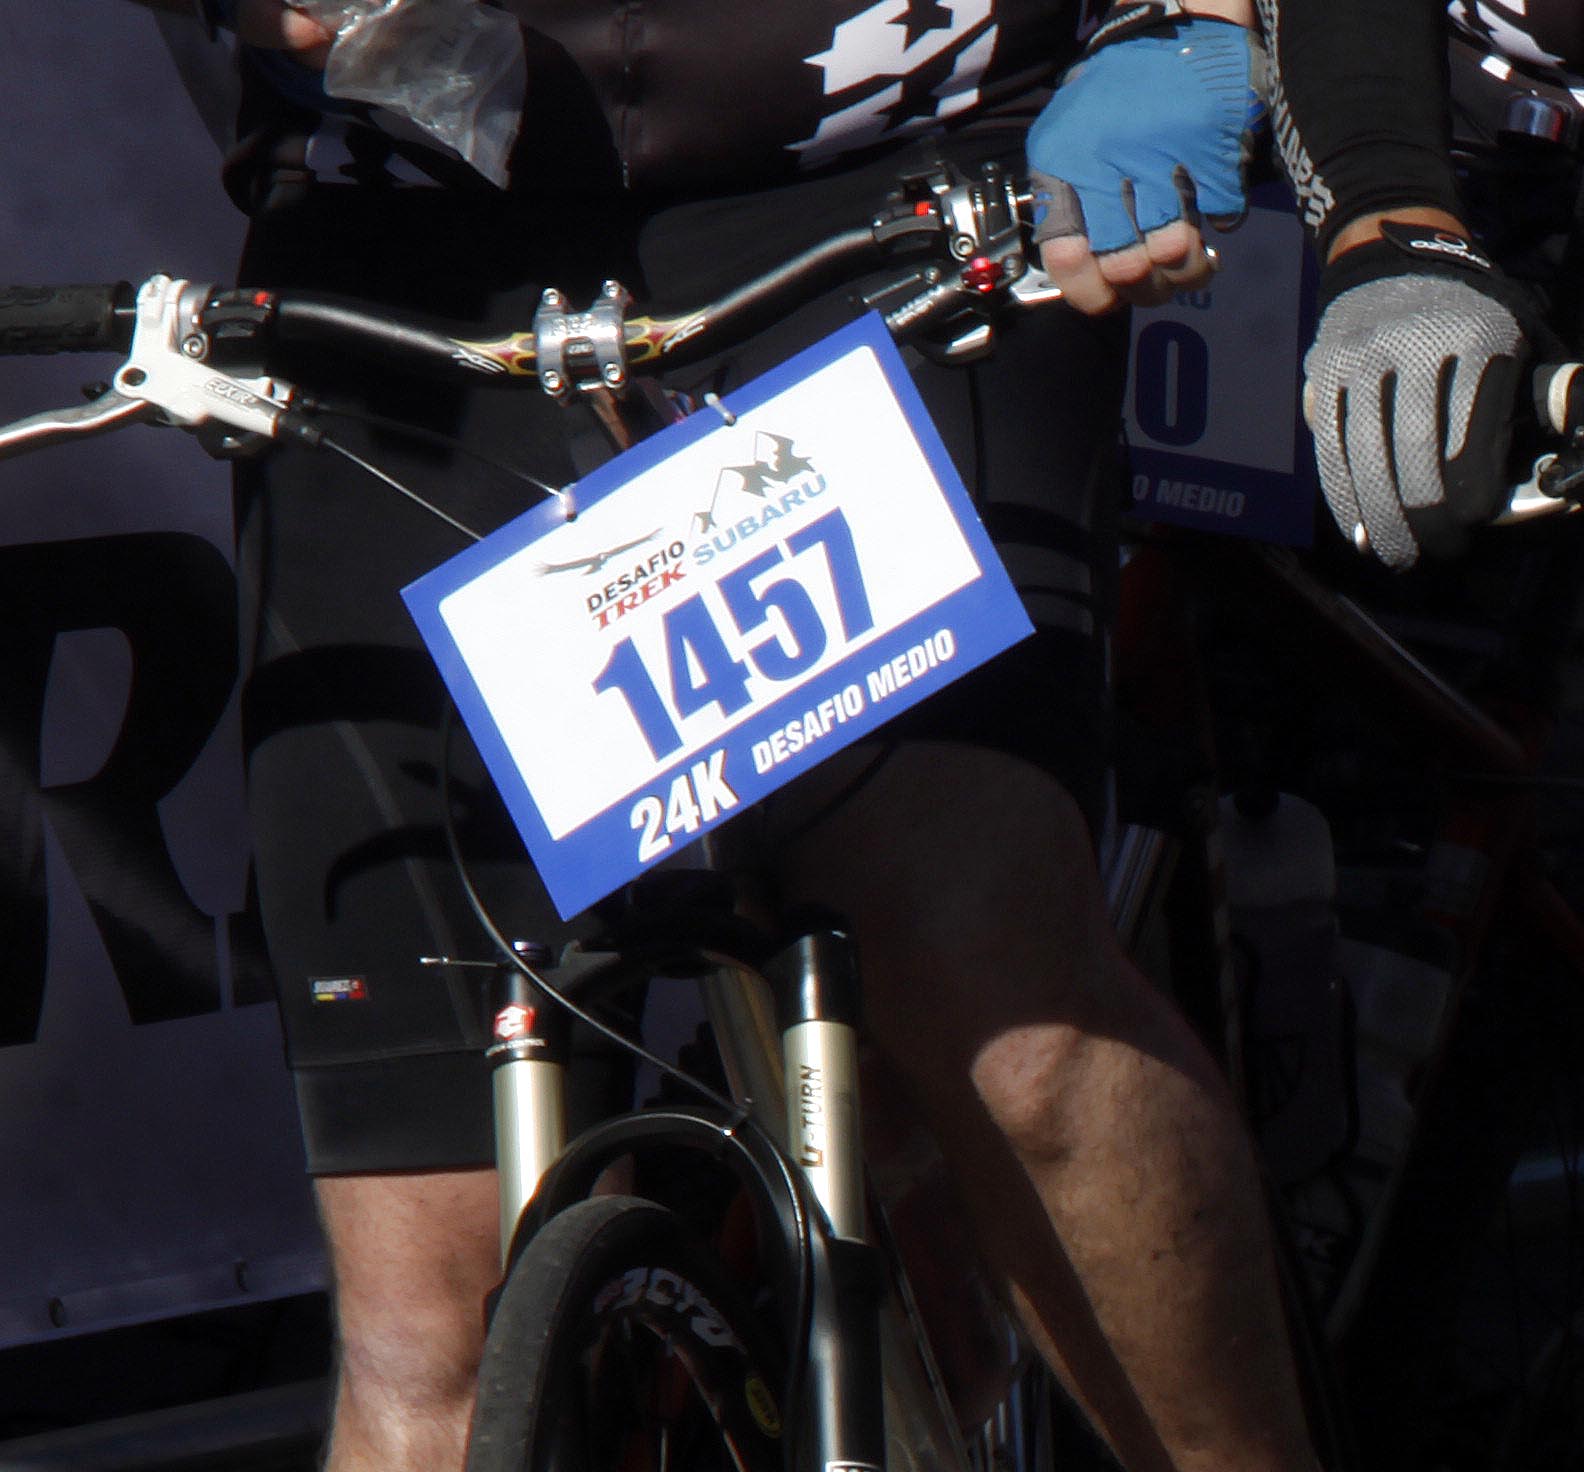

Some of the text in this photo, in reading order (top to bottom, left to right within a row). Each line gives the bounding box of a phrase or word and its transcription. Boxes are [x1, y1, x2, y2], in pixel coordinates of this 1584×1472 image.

[692, 473, 828, 570] SUBARU
[585, 540, 686, 614] DESAFIO
[591, 562, 688, 632] TREK
[591, 506, 876, 764] 1457
[629, 628, 956, 864] 24K DESAFIO MEDIO
